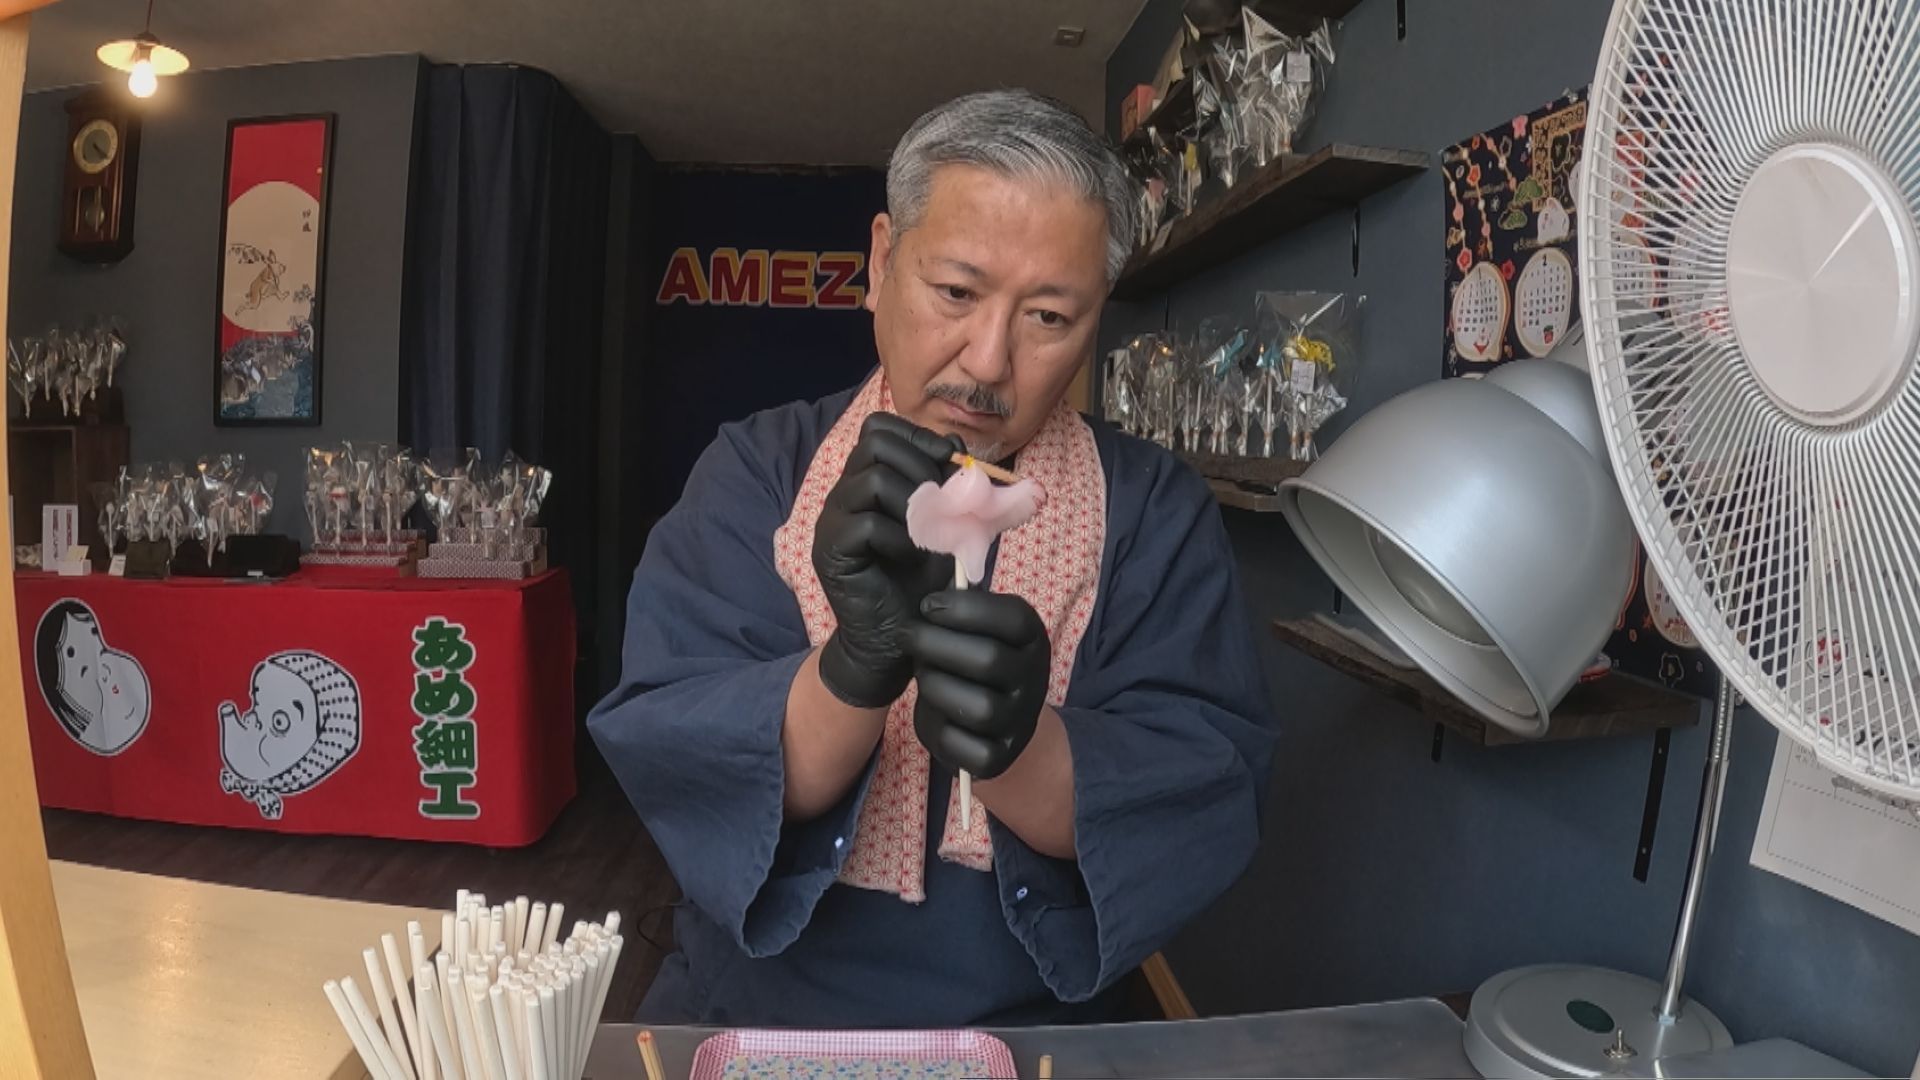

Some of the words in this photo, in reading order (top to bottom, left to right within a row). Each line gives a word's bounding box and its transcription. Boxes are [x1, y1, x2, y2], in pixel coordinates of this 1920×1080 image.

[656, 247, 866, 310] AMEZ
[411, 616, 481, 819] あめ細工
